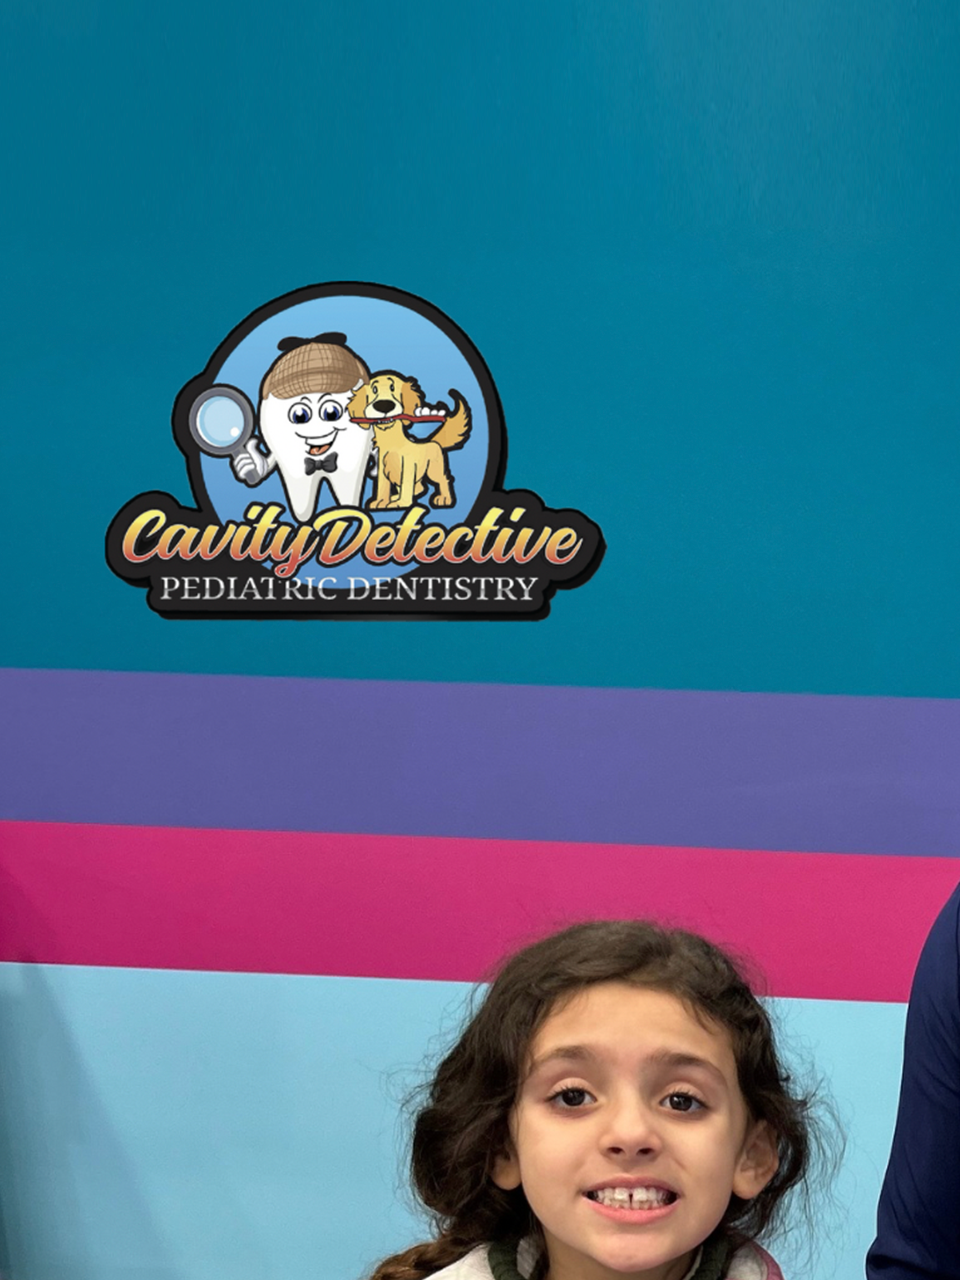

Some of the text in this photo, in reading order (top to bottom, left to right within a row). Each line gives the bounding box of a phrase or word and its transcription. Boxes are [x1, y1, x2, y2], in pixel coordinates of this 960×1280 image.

[122, 503, 583, 577] Cavity Detective
[161, 576, 538, 600] PEDIATRIC DENTISTRY
